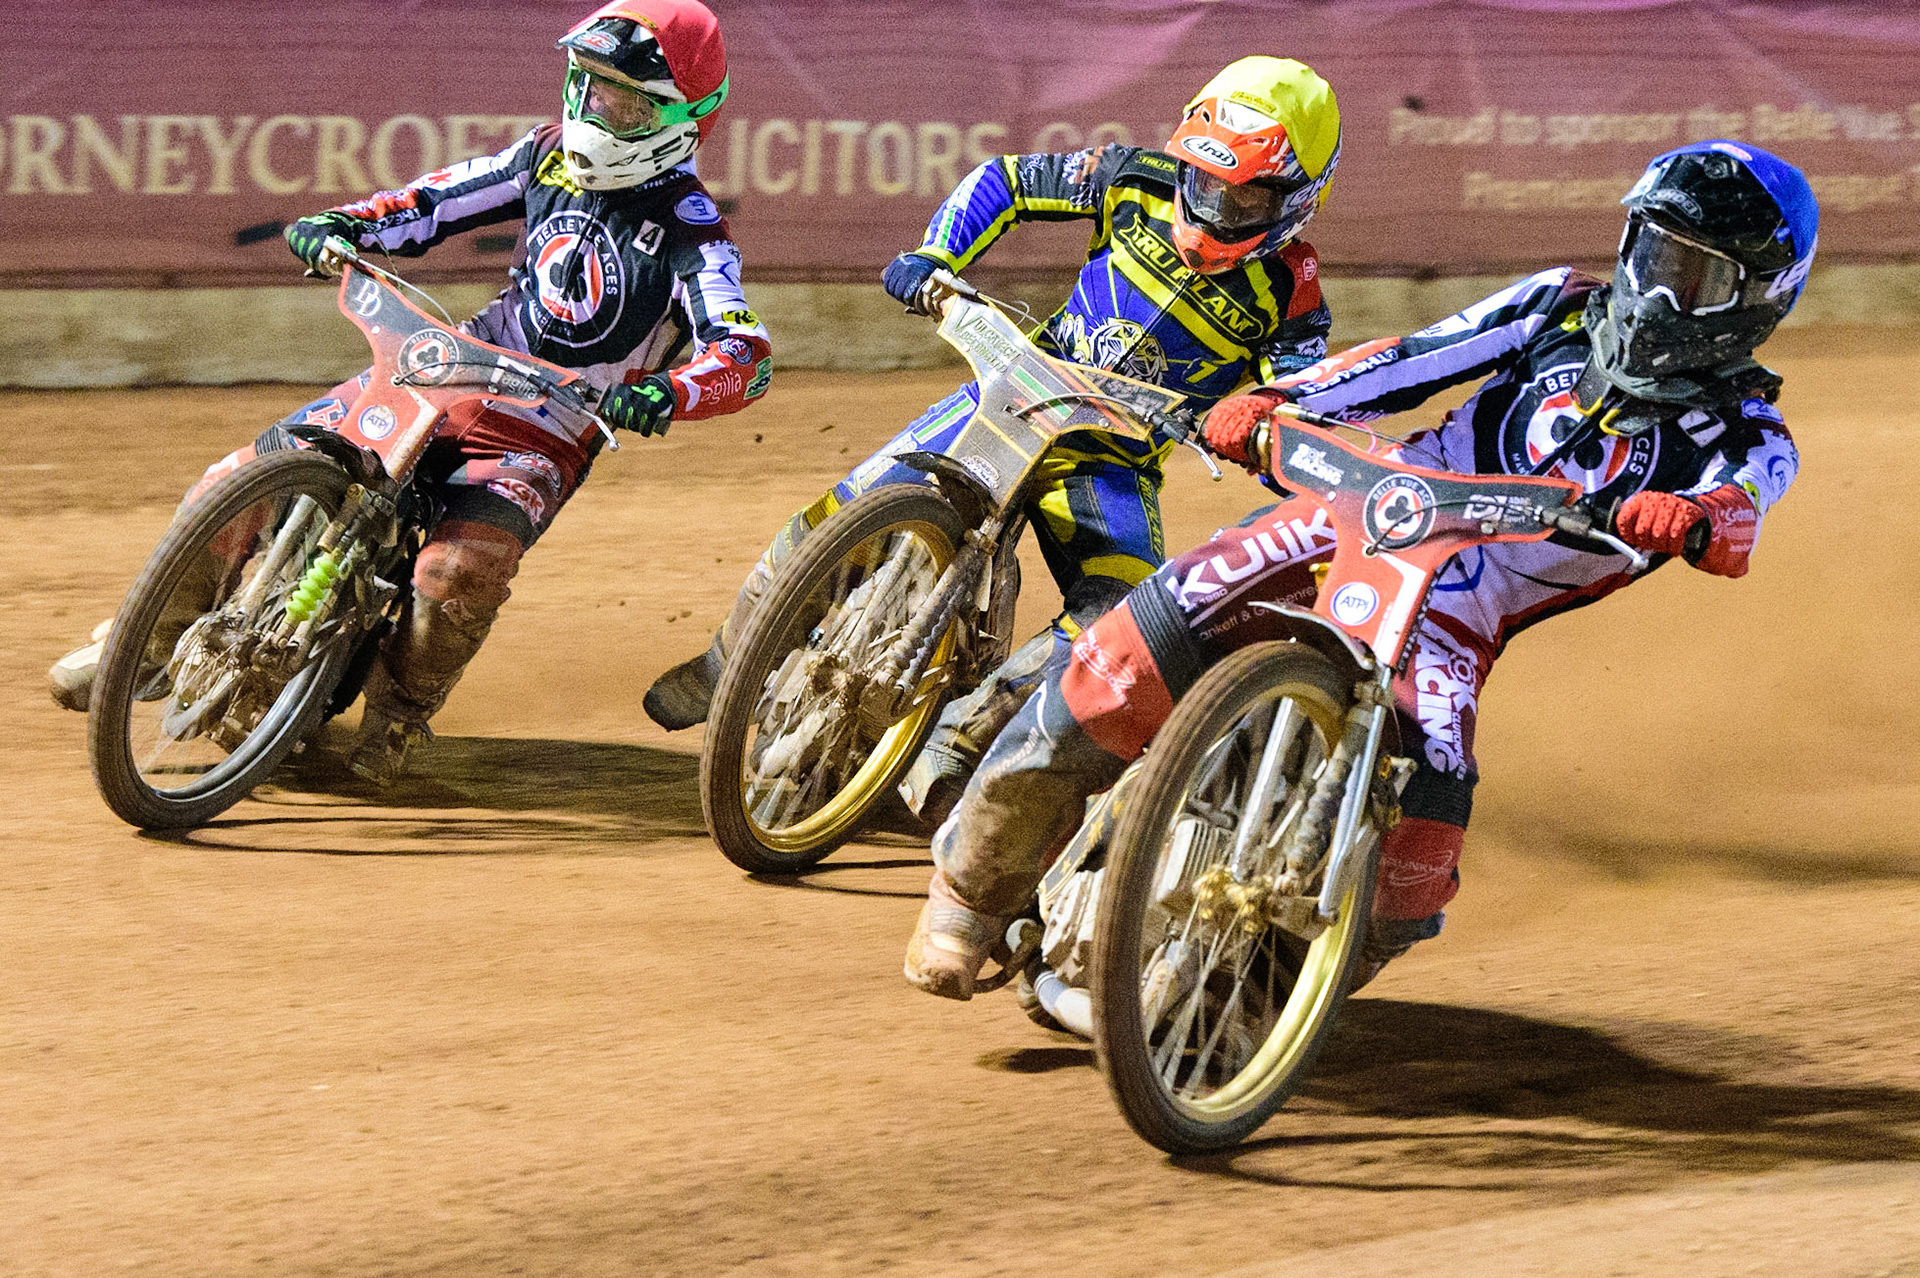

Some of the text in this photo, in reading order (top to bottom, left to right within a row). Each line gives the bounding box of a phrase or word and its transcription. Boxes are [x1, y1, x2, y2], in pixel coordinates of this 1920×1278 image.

[703, 119, 1006, 197] ICITORS
[536, 219, 577, 247] BELLE
[600, 252, 618, 296] ACES
[639, 226, 661, 251] 4
[1131, 222, 1177, 271] TRU
[1632, 437, 1651, 476] CES
[1372, 479, 1397, 501] BELLE
[1401, 479, 1419, 491] VUE
